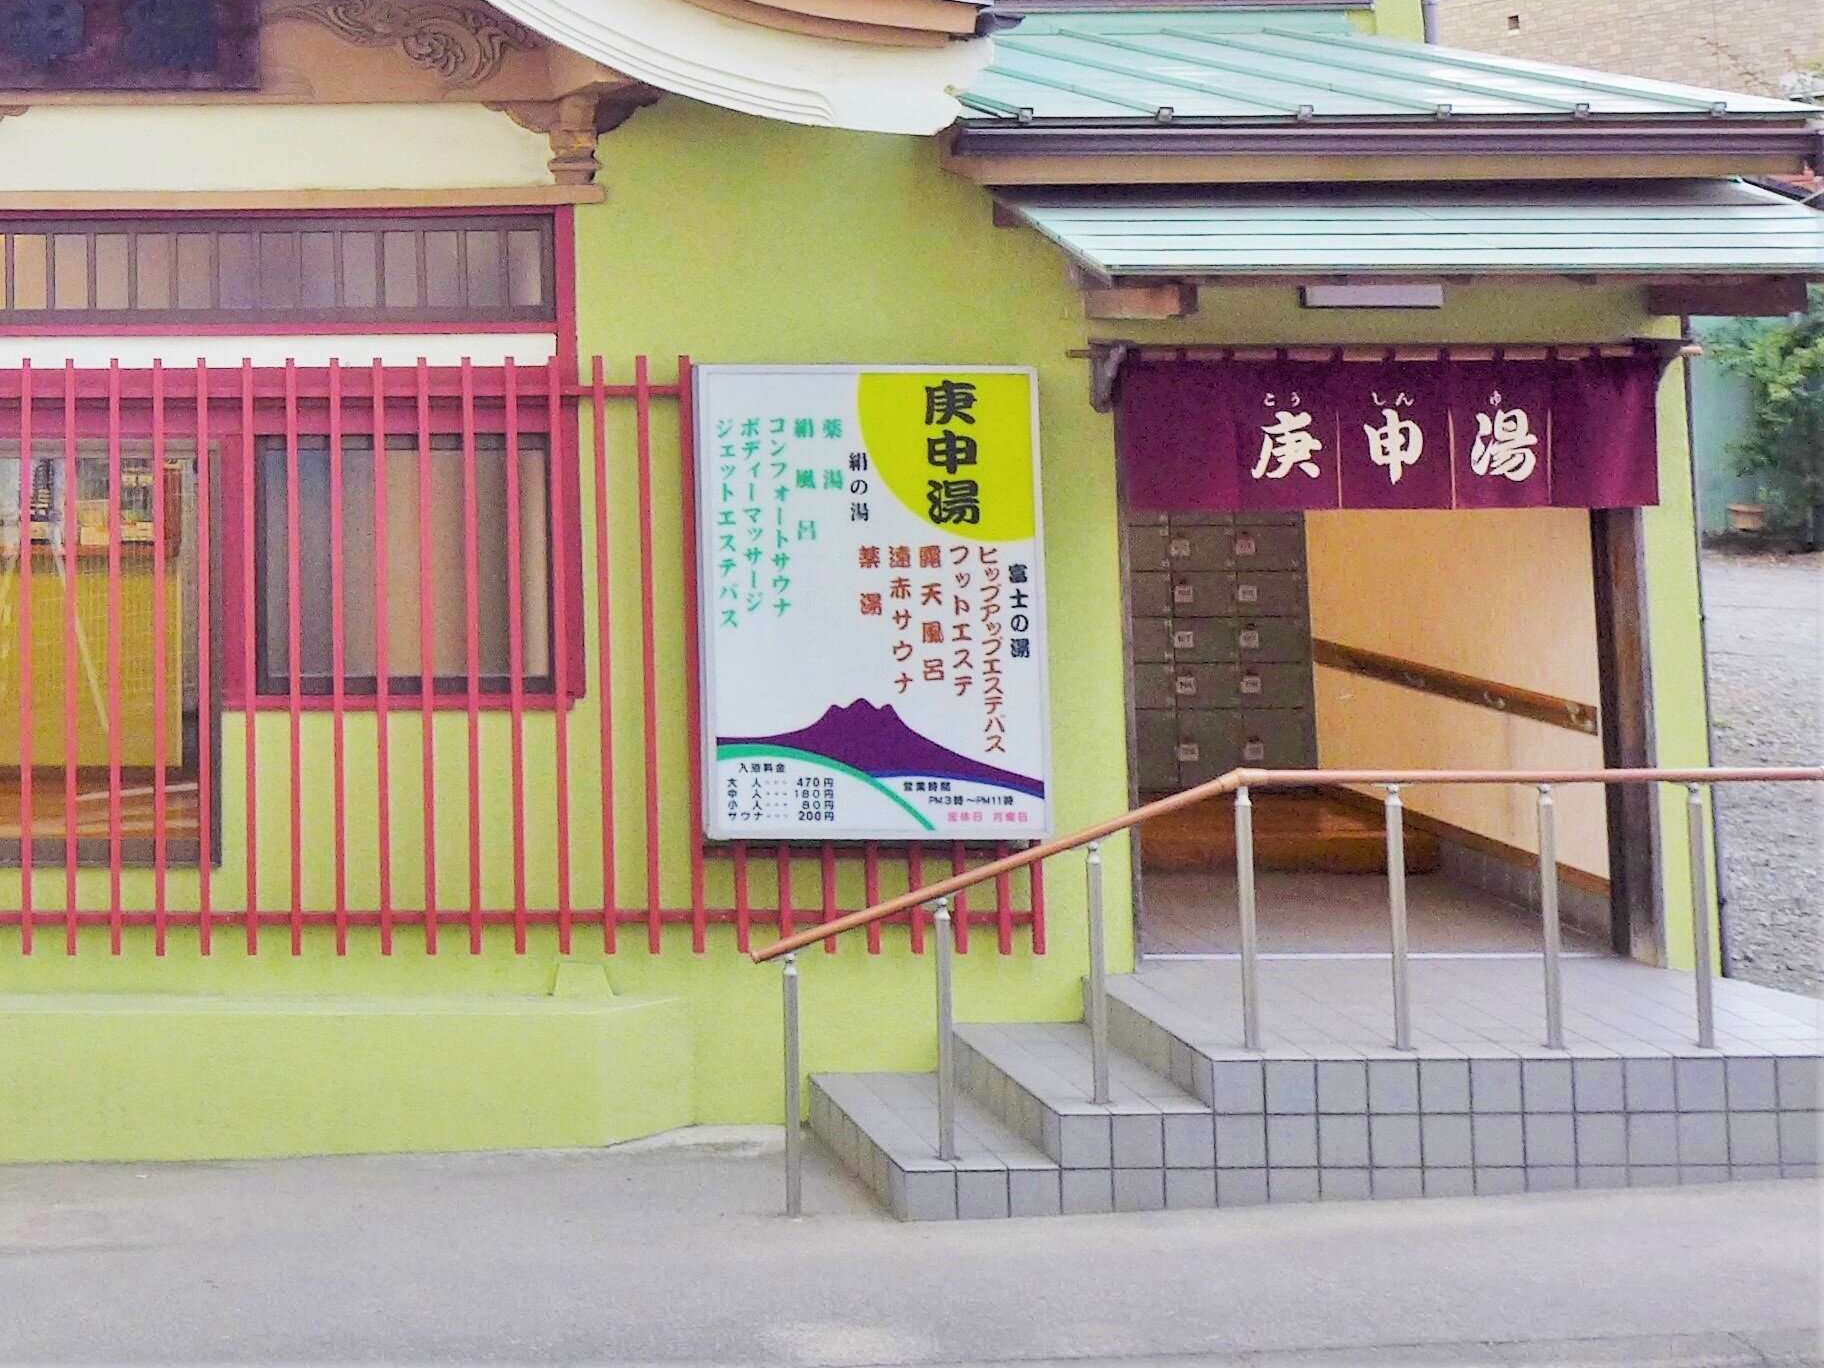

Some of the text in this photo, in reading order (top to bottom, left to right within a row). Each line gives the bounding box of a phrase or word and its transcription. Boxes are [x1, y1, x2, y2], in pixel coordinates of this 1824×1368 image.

[740, 418, 764, 612] ボディーマッサージ
[769, 418, 791, 617] コンフォートサウナ
[849, 452, 869, 522] 絹の湯
[925, 379, 980, 525] 庚申湯
[1251, 408, 1538, 485] 庚申湯
[716, 419, 738, 628] ジェットエステバス
[888, 545, 913, 694] 遠赤サウナ
[950, 545, 973, 696] フットエステ
[1008, 563, 1030, 658] 富士の湯
